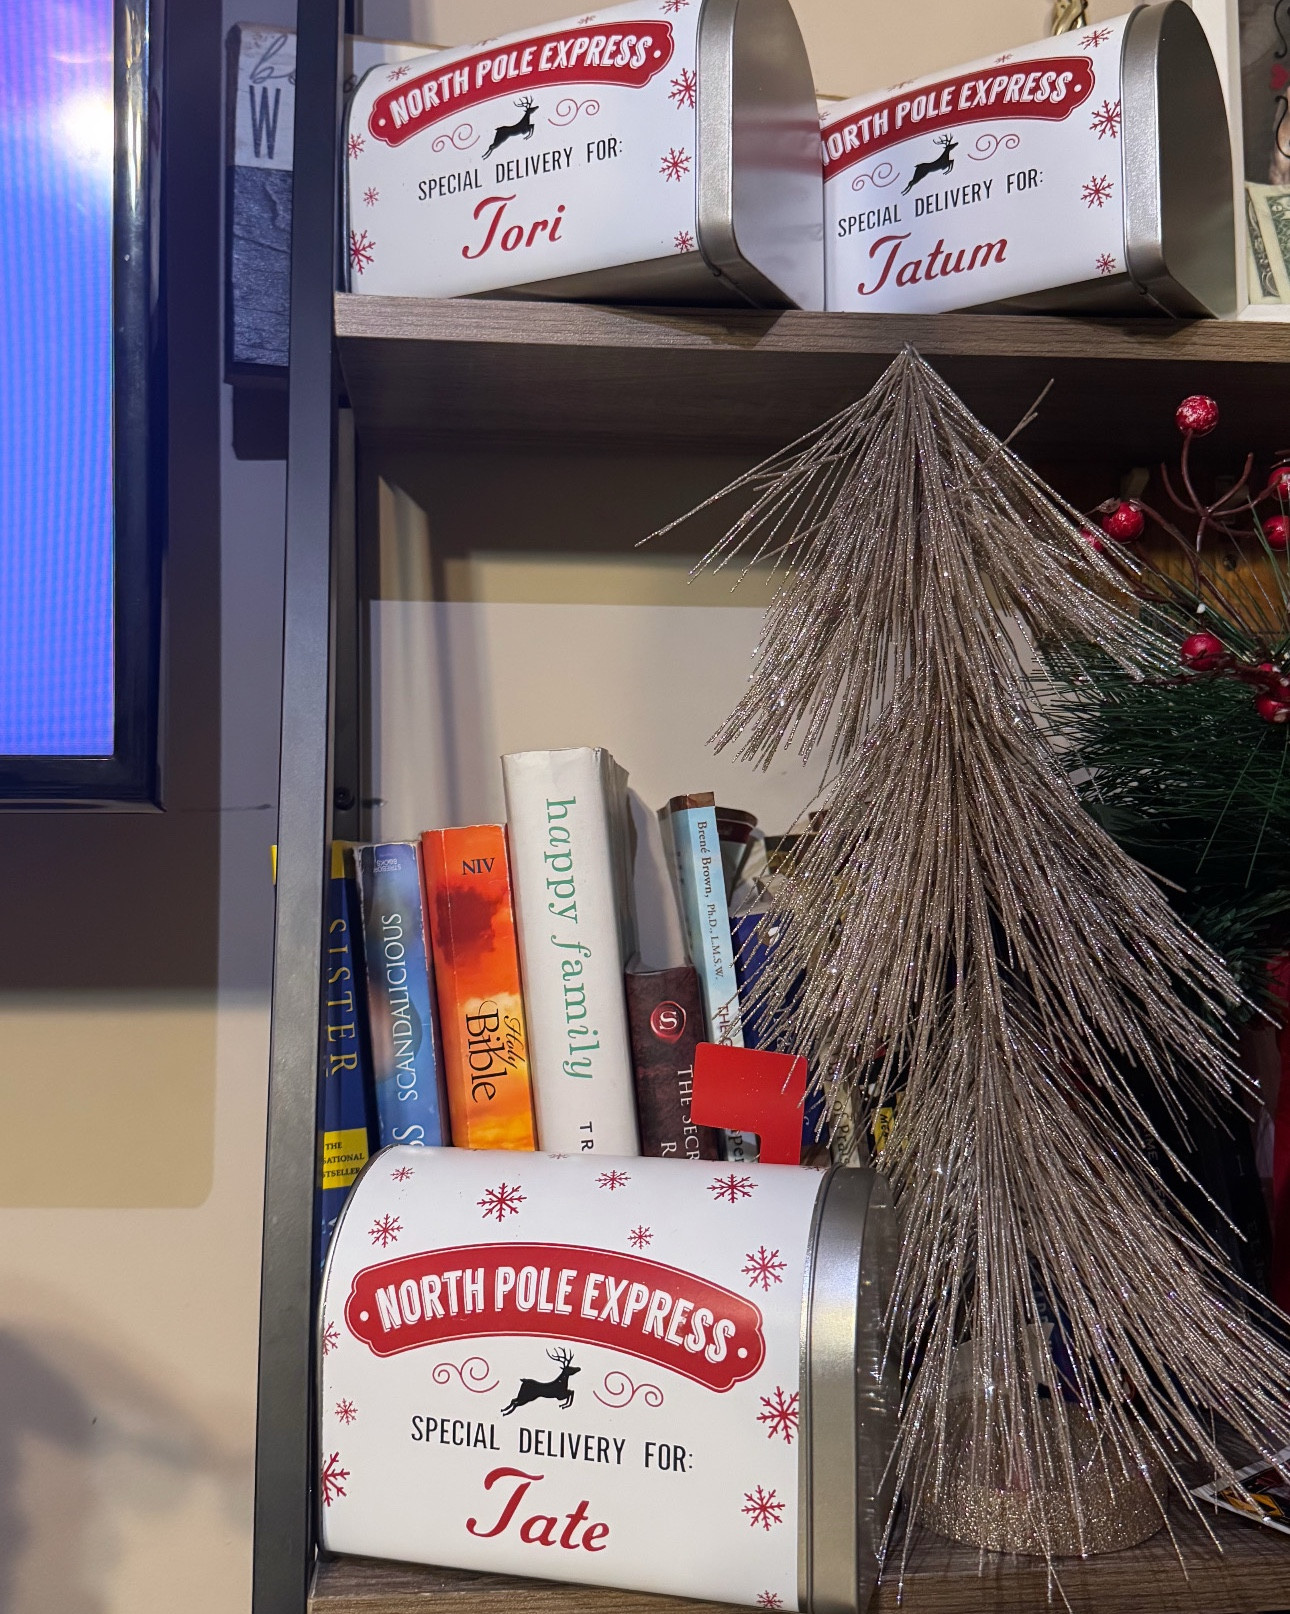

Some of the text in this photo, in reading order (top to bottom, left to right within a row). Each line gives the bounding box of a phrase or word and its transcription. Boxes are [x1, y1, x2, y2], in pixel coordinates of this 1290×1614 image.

[389, 35, 653, 129] NORTH POLE EXPRESS
[895, 86, 956, 130] POLE
[958, 71, 1073, 110] EXPRESS
[418, 137, 623, 201] SPECIAL DELIVERY FOR:
[462, 194, 566, 260] Tori
[838, 168, 1043, 237] SPECIAL DELIVERY FOR:
[857, 232, 1008, 295] Tatum
[462, 857, 496, 876] NIV
[697, 820, 709, 854] Brené
[701, 856, 713, 898] Brown,
[545, 796, 602, 1080] happy family
[325, 918, 358, 1077] SISTER
[381, 913, 418, 1101] SCANDALICIOUS
[465, 1001, 508, 1104] Bible
[502, 1014, 528, 1071] Holy
[677, 1064, 694, 1107] THE
[325, 1141, 342, 1151] THE
[375, 1264, 736, 1364] NORTH POLE EXPRESS
[410, 1415, 694, 1473] SPECIAL DELIVERY FOR:
[466, 1467, 610, 1552] Tate
